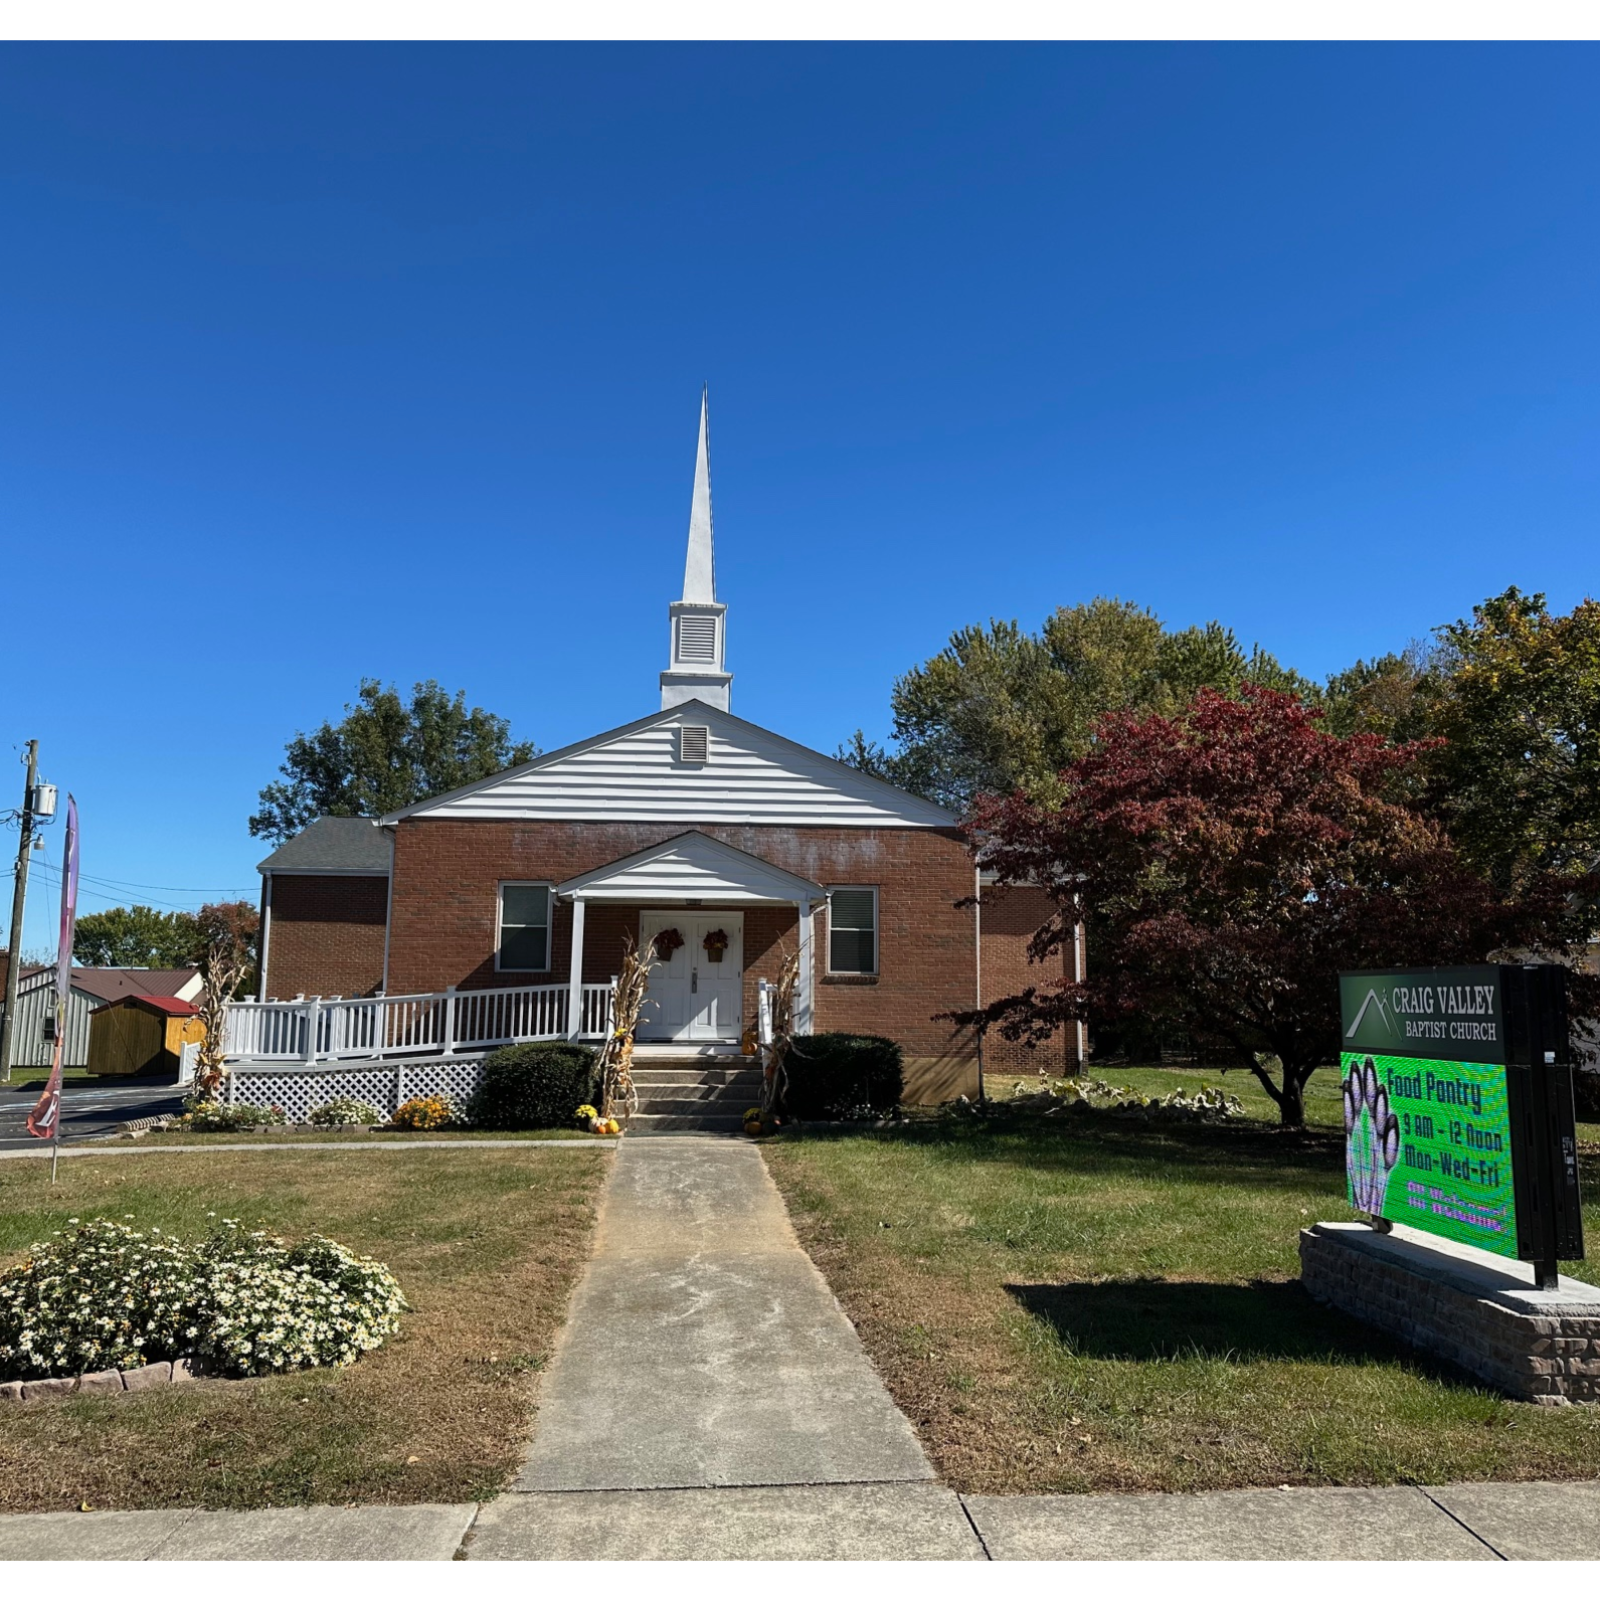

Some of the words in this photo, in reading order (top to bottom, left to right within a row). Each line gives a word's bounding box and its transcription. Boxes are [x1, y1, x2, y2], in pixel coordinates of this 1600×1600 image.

[1393, 987, 1434, 1014] CRAIG
[1437, 986, 1494, 1014] VALLEY
[1406, 1021, 1447, 1038] BAPTIST
[1450, 1022, 1496, 1040] CHURCH
[1387, 1068, 1421, 1099] Food
[1426, 1072, 1481, 1115] Pantry
[1404, 1113, 1410, 1134] 9
[1415, 1115, 1433, 1139] AM
[1450, 1120, 1461, 1144] 12
[1466, 1123, 1502, 1152] Noon
[1405, 1145, 1499, 1187] Mon-Wed-Fri
